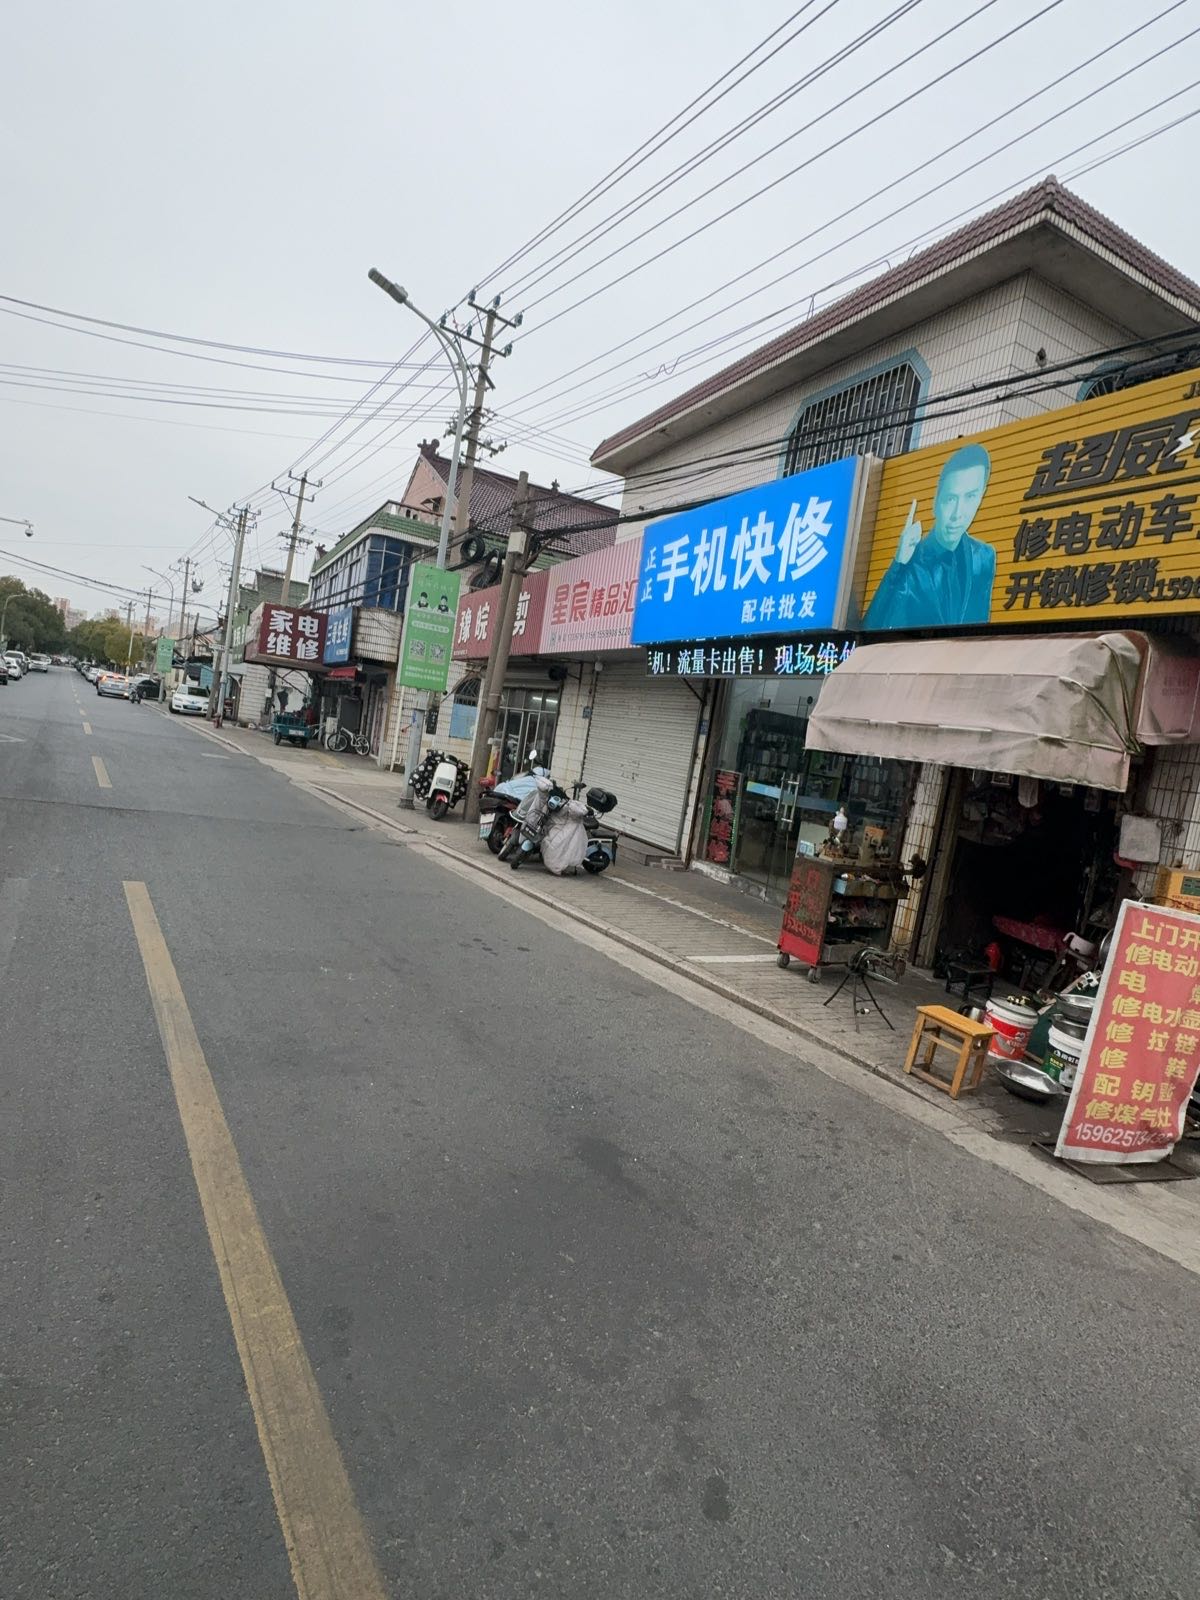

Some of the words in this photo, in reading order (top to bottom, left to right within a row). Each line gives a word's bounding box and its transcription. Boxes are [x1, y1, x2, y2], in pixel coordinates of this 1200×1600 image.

[1023, 408, 1200, 500] 超威
[1012, 493, 1200, 562] 修电动车
[656, 496, 833, 603] 手机快修
[1003, 557, 1160, 610] 开锁修锁
[269, 609, 319, 638] 家电
[741, 590, 817, 624] 配件批发
[266, 632, 319, 660] 维修
[1125, 942, 1200, 977] 修电动
[1085, 1098, 1172, 1128] 修煤气灶
